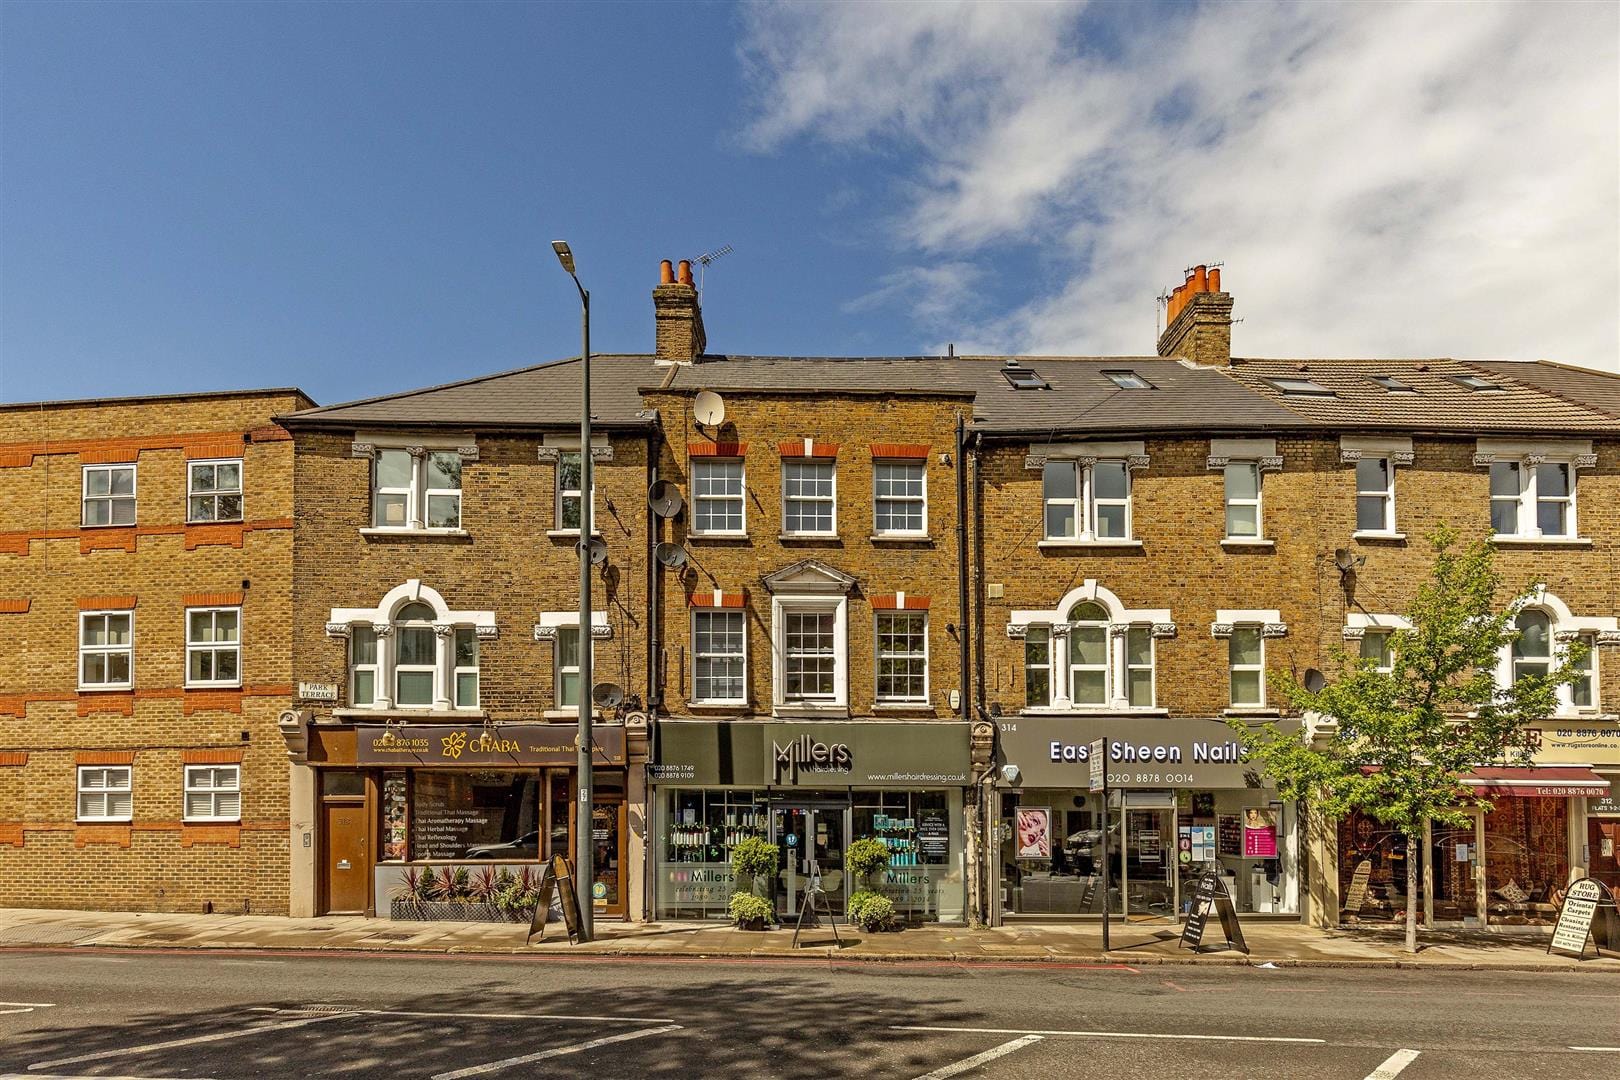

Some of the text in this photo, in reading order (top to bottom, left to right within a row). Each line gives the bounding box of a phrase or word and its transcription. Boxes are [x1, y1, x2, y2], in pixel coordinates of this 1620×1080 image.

[1001, 723, 1017, 732] 314
[1557, 729, 1572, 737] 020
[1600, 729, 1620, 737] 0070
[411, 739, 429, 747] 1035
[469, 740, 521, 753] CHABA
[1051, 741, 1249, 761] Eas Sheen Nails
[773, 734, 849, 780] Millers
[867, 773, 967, 783] www.millershairdressing.co.uk
[1107, 774, 1194, 783] 020 8878 0014
[427, 834, 457, 842] Reflexology
[691, 869, 735, 882] Millers
[887, 872, 930, 884] Millers
[1572, 890, 1599, 899] STORE
[1568, 901, 1594, 909] Oriental
[1567, 907, 1590, 916] Carpets
[1561, 916, 1584, 926] Cleaning
